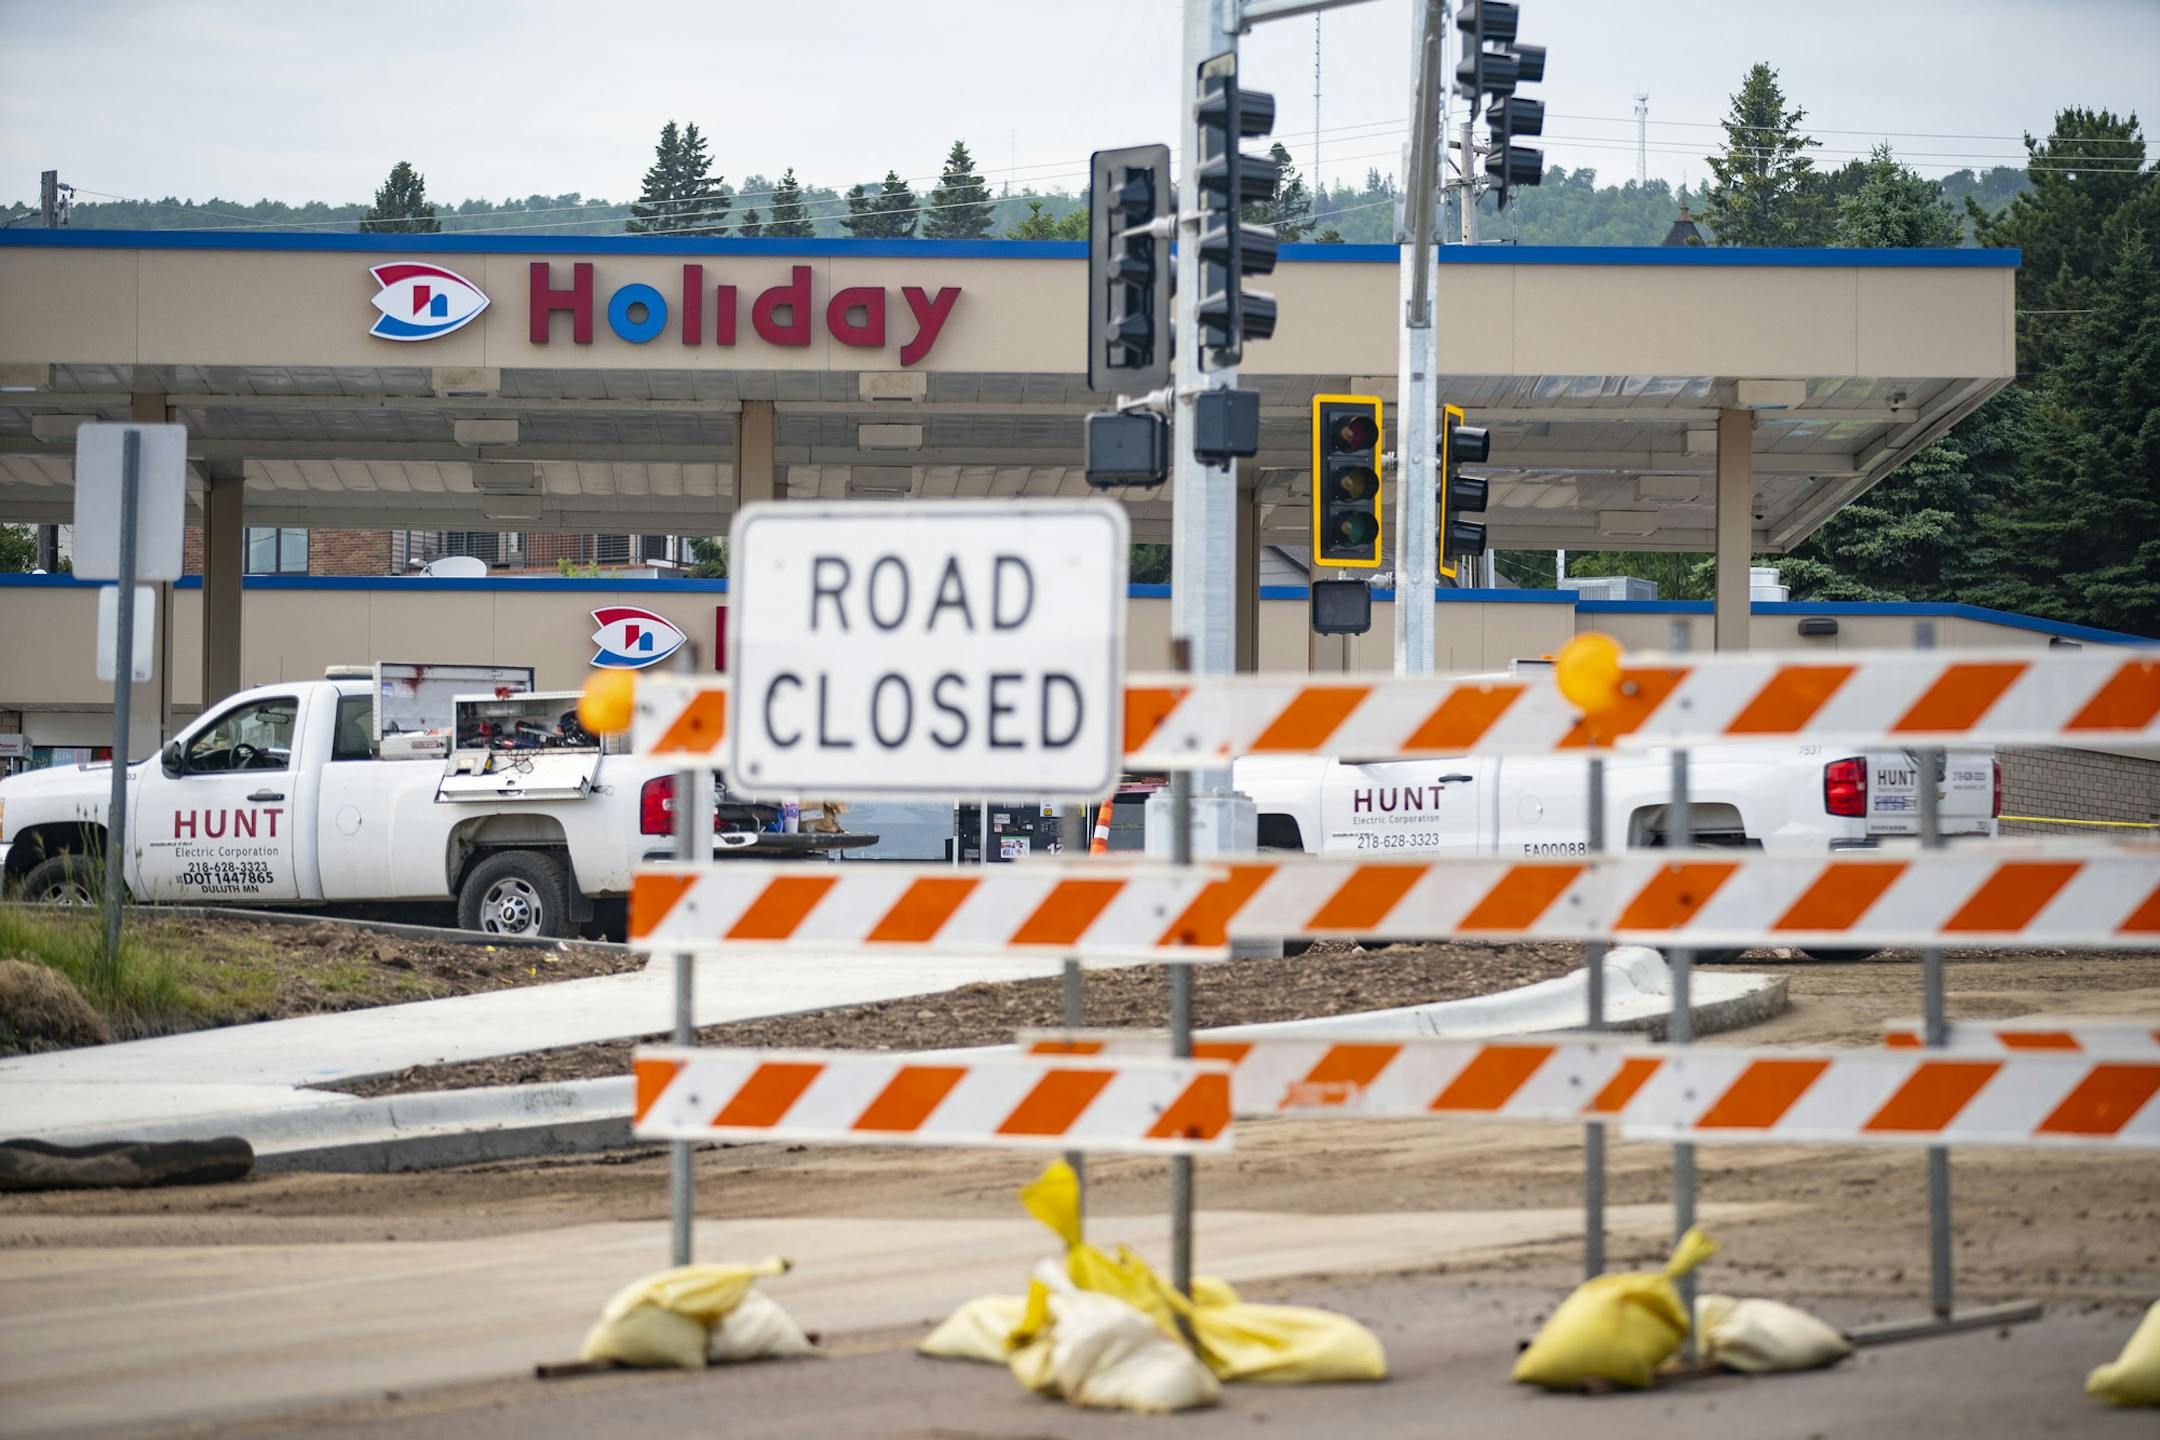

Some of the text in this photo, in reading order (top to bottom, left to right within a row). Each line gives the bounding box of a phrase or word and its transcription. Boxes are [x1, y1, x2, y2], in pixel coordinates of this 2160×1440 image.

[529, 262, 963, 366] Holiday
[812, 555, 1033, 631] ROAD
[765, 672, 1083, 750] CLOSED
[1877, 769, 1916, 786] HUNT
[1353, 785, 1446, 813] HUNT
[174, 808, 284, 839] HUNT
[1353, 813, 1440, 826] Electric Corporation
[1357, 832, 1439, 849] 218-628-3323
[175, 845, 279, 859] Electric Corporation
[188, 861, 268, 873] 218-628-3323
[183, 872, 213, 886] DOT
[215, 871, 274, 885] 1447865
[202, 884, 260, 894] DULUTH MN
